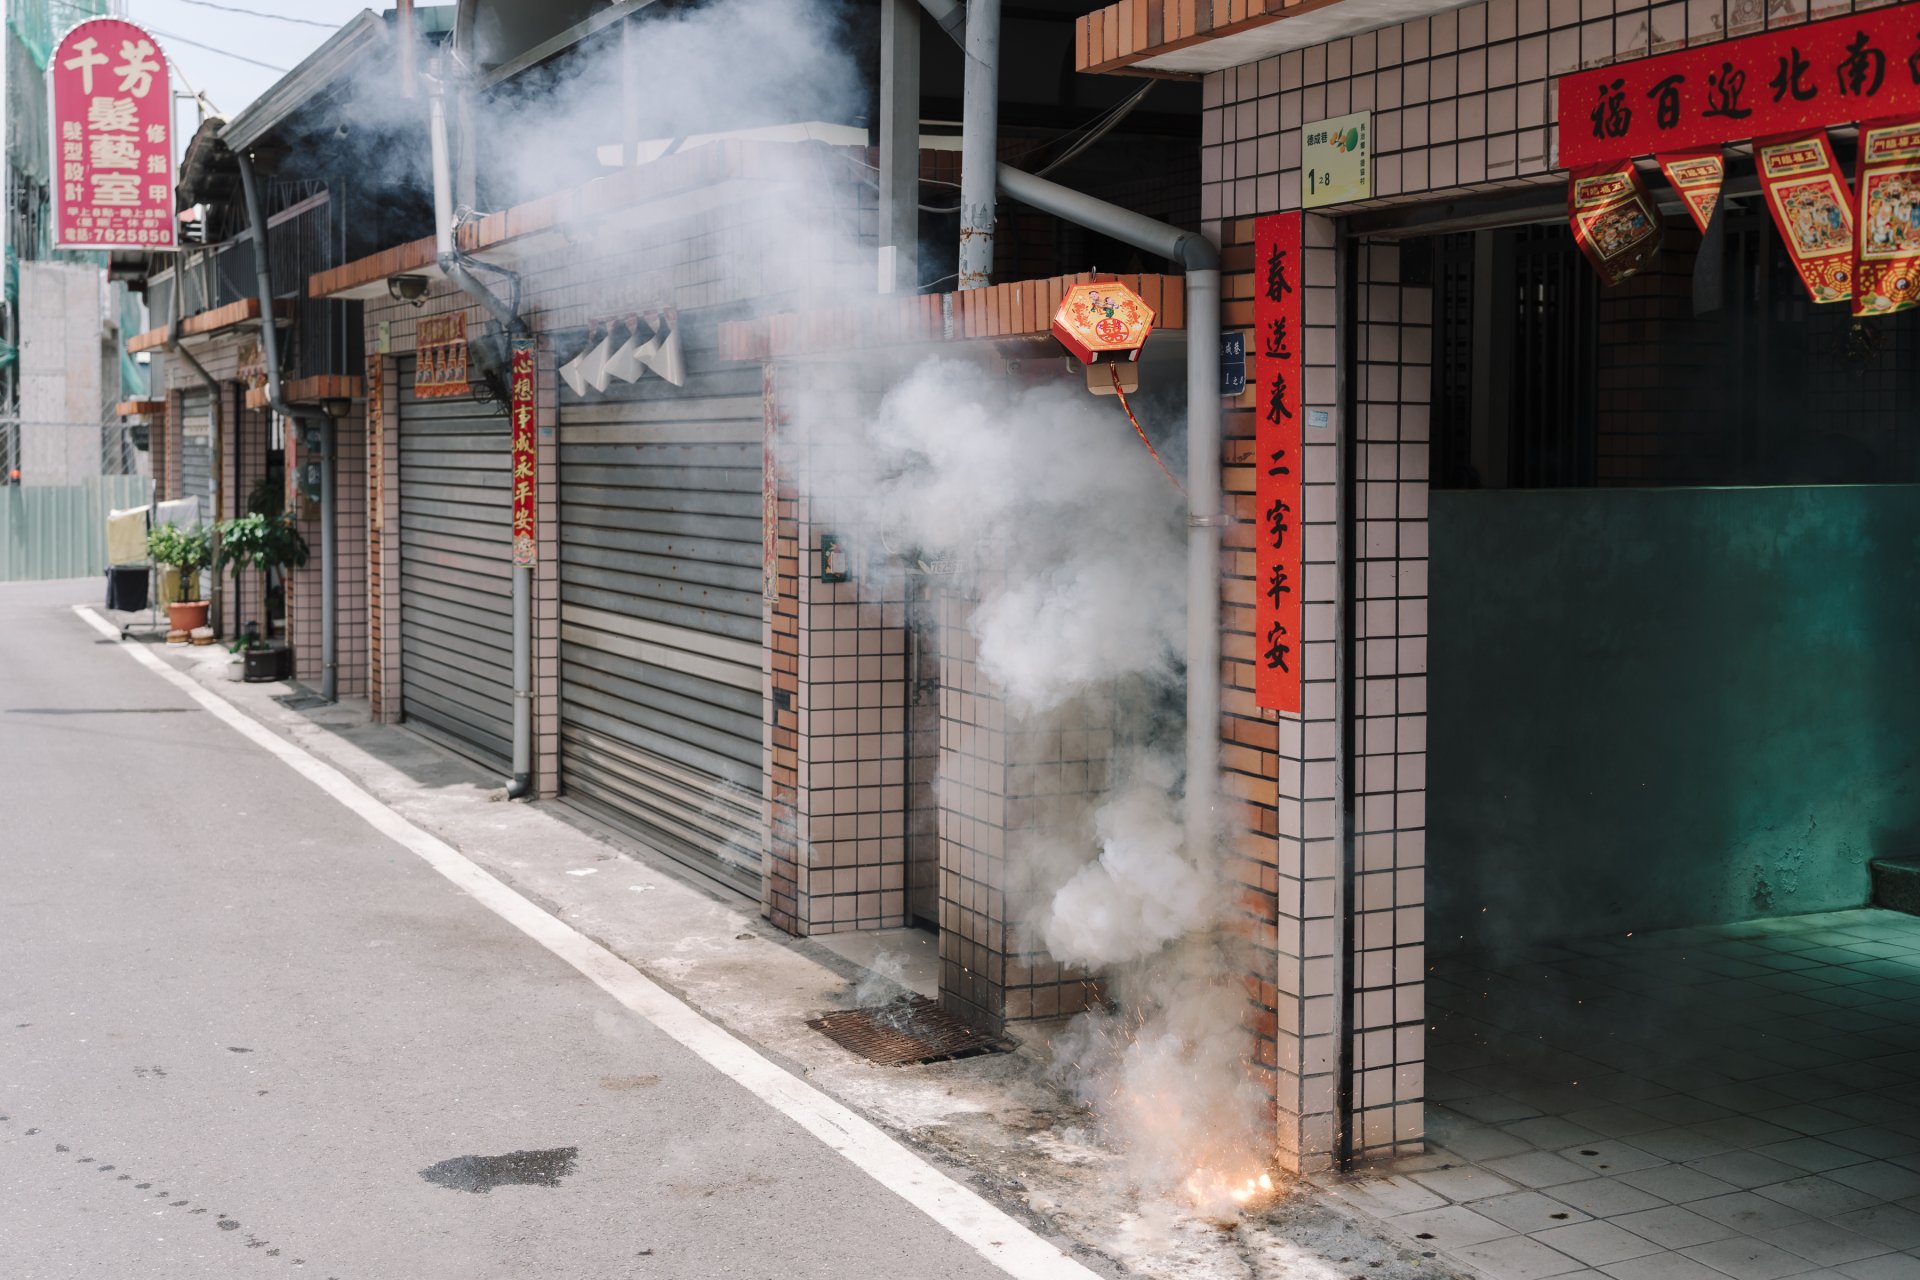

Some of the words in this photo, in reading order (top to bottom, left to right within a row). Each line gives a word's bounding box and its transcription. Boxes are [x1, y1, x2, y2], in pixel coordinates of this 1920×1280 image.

[63, 36, 161, 98] 千芳
[63, 121, 84, 203] 髮型設計
[88, 96, 142, 206] 髮藝室
[146, 124, 168, 204] 修指甲
[513, 358, 534, 531] 心想事成永平安
